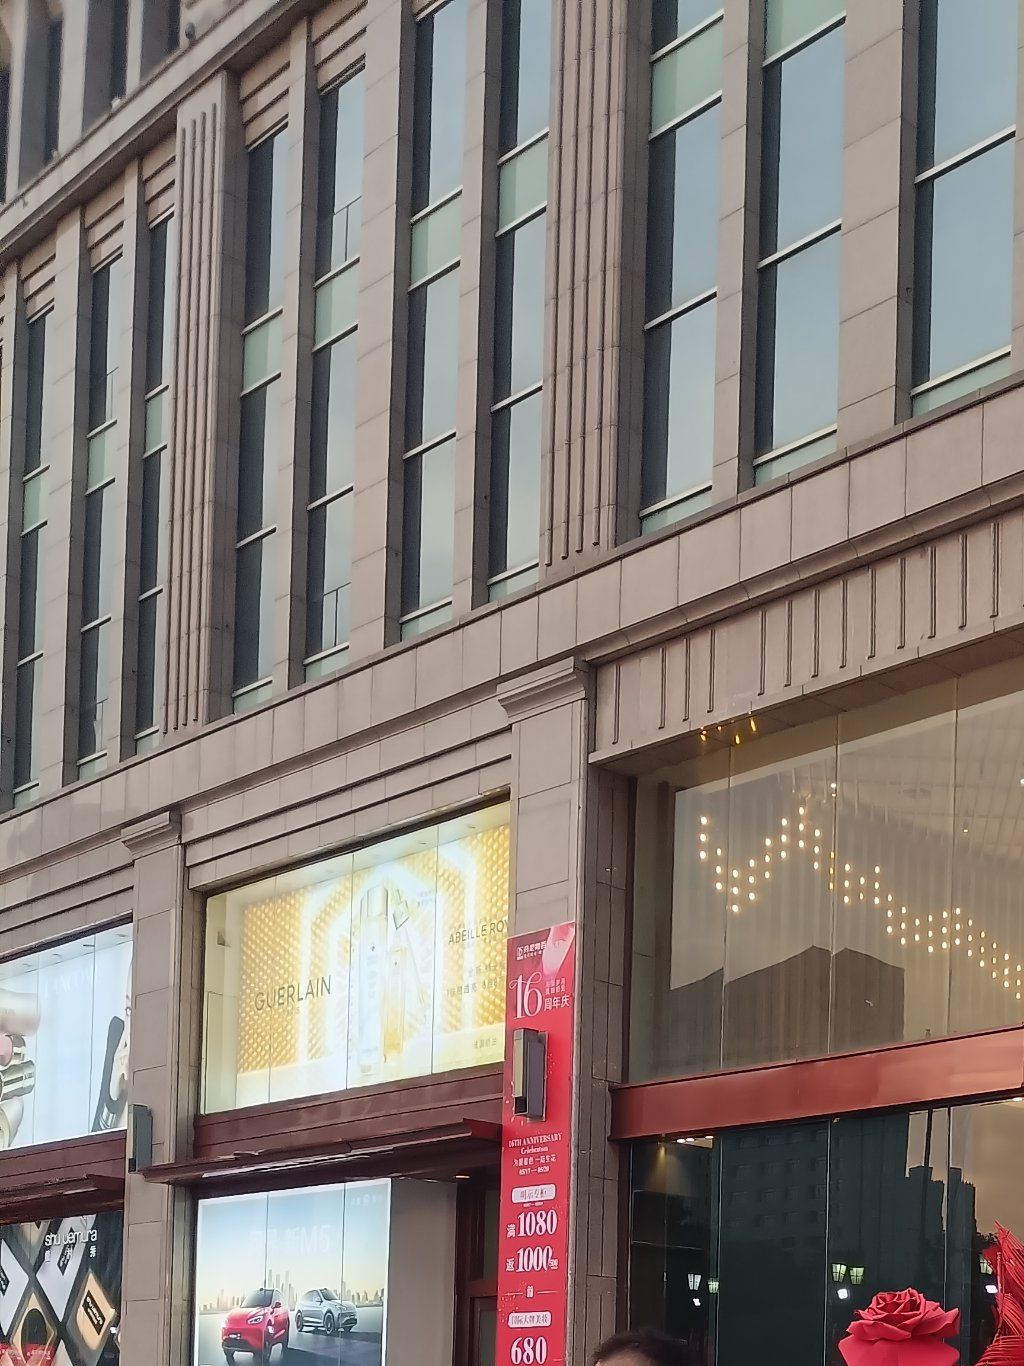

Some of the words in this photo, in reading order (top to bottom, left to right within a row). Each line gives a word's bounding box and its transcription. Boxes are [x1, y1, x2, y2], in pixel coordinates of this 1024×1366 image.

[255, 975, 331, 1011] GUERLAIN
[509, 972, 542, 1019] 16
[511, 1337, 547, 1365] 680
